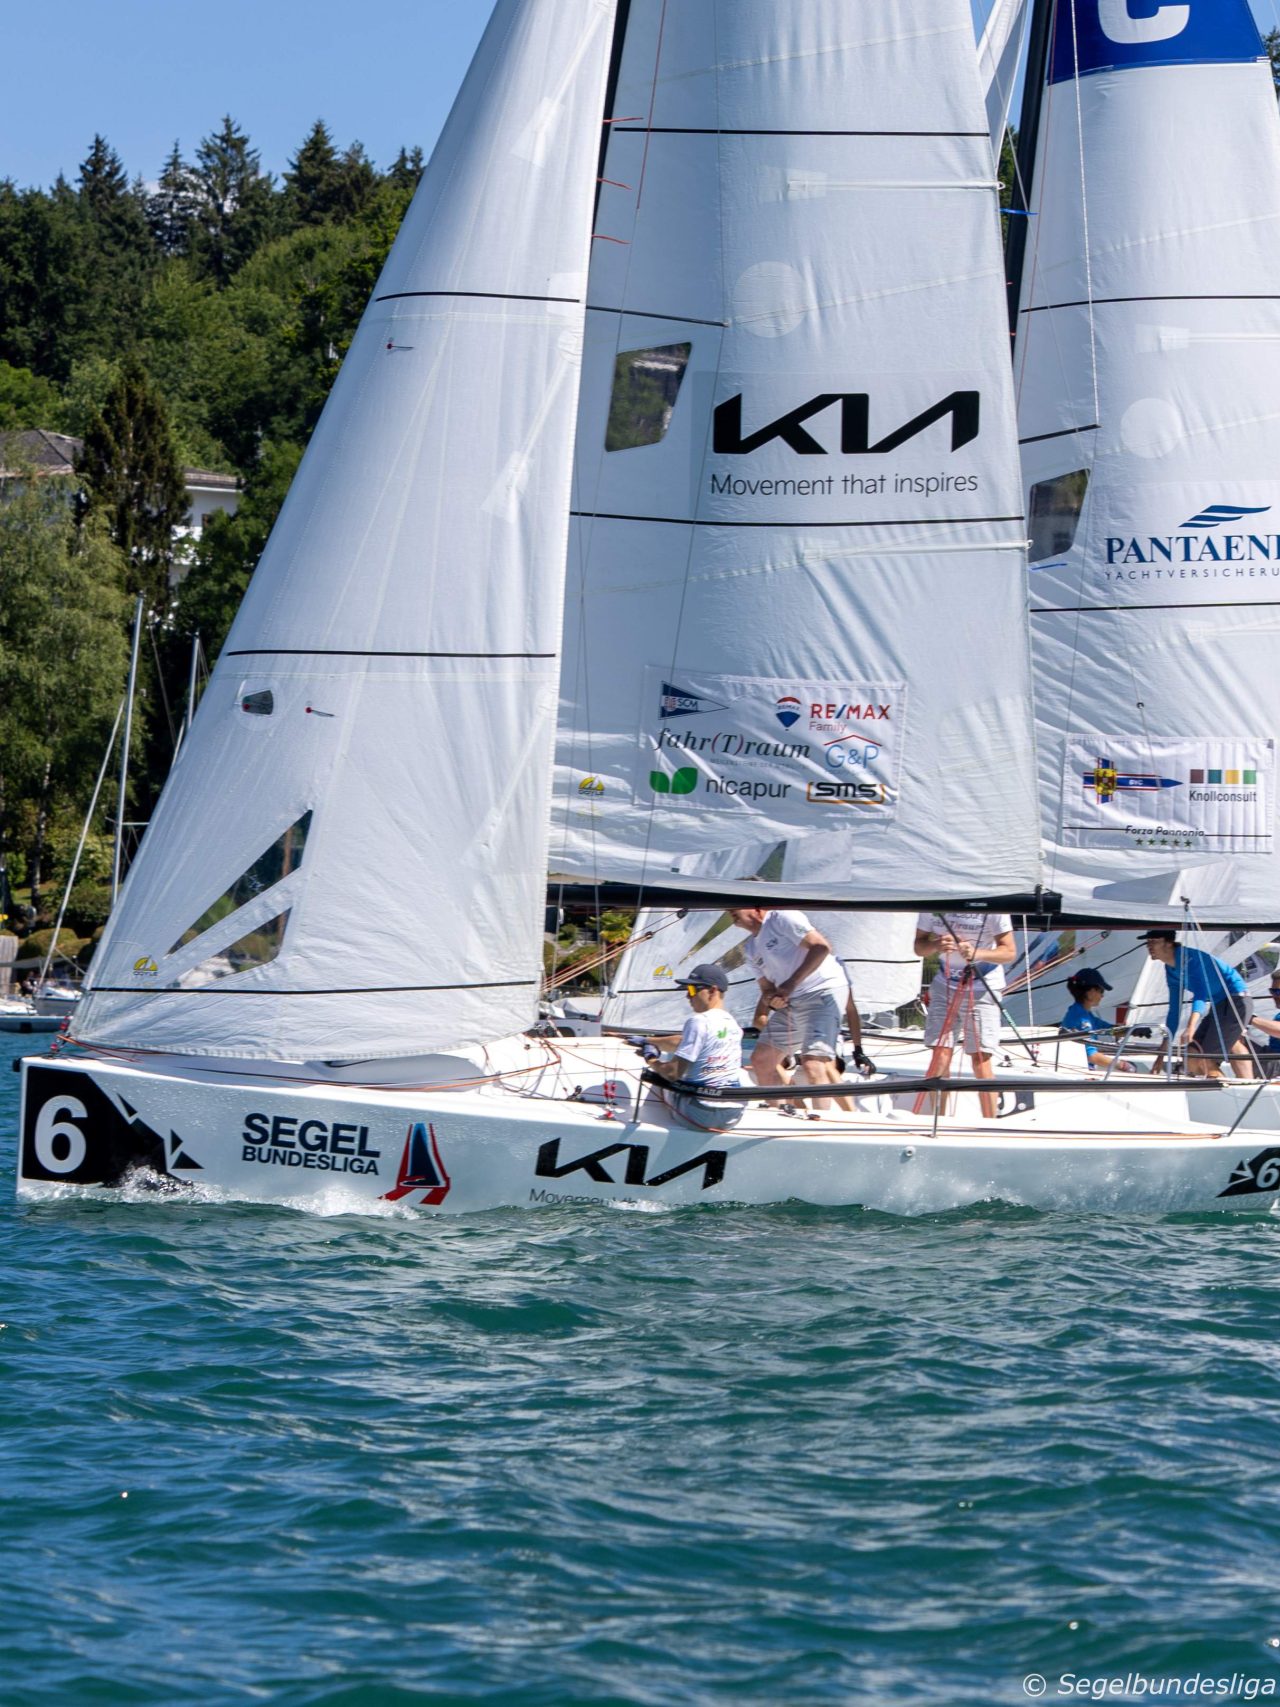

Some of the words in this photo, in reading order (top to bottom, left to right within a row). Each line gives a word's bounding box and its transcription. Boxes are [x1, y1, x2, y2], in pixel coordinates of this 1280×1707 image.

[713, 391, 980, 455] KIA
[711, 474, 834, 496] Movement
[841, 474, 886, 494] that
[894, 473, 978, 498] inspires
[809, 721, 848, 734] Family
[810, 703, 891, 720] RE/MAX
[652, 727, 811, 759] fahr(T)raum
[824, 744, 880, 769] G&P
[705, 776, 792, 800] nicapur
[34, 1094, 88, 1174] 6
[242, 1113, 381, 1159] SEGEL
[241, 1144, 380, 1177] BUNDESLIGA
[535, 1137, 728, 1190] KIA
